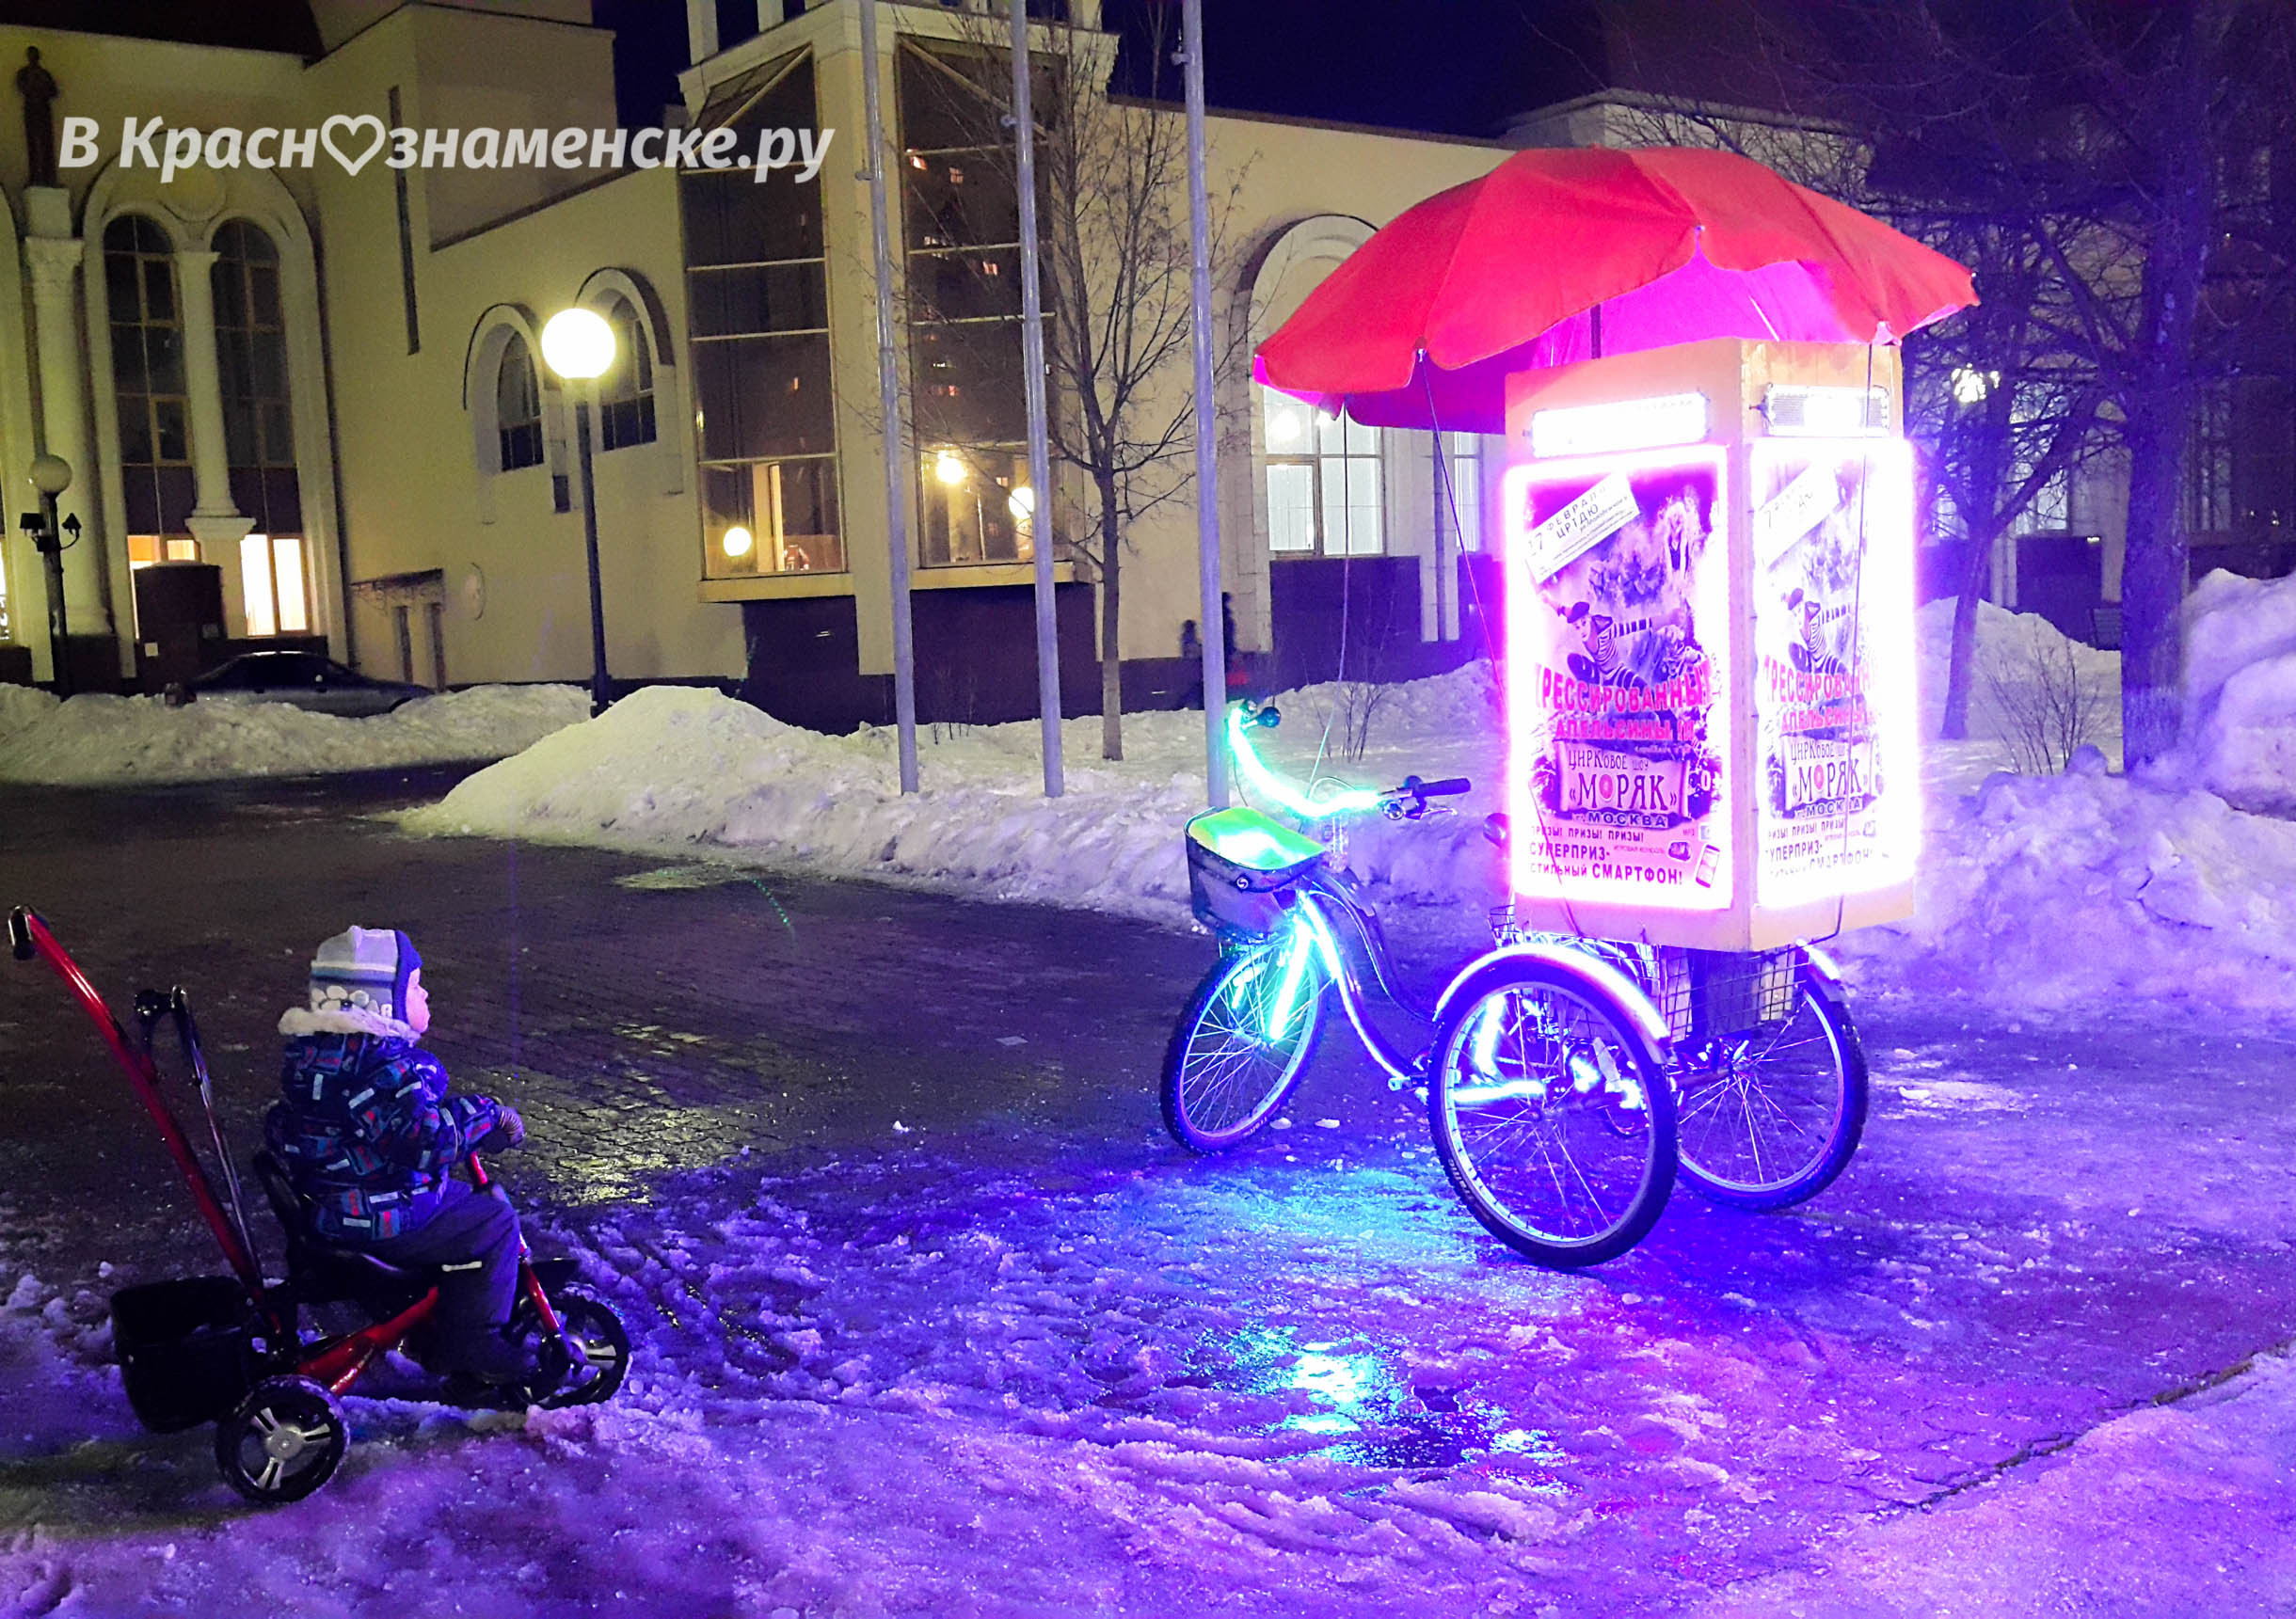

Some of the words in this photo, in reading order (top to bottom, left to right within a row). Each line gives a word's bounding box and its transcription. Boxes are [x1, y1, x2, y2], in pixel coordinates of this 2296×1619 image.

[1546, 485, 1607, 532] ФЕВРАЛ
[1569, 772, 1678, 811] «МОРЯК»
[1587, 812, 1666, 827] МОСКВА
[1821, 817, 1846, 833] ПРИЗЫ
[1568, 827, 1602, 840] ПРИЗЫ!
[1608, 830, 1645, 843] ПРИЗЫ!
[1765, 839, 1823, 862] УПЕРПРИЗ-
[1530, 863, 1587, 877] СТИЛЬНЫЙ
[1592, 863, 1682, 885] СМАРТФОН!
